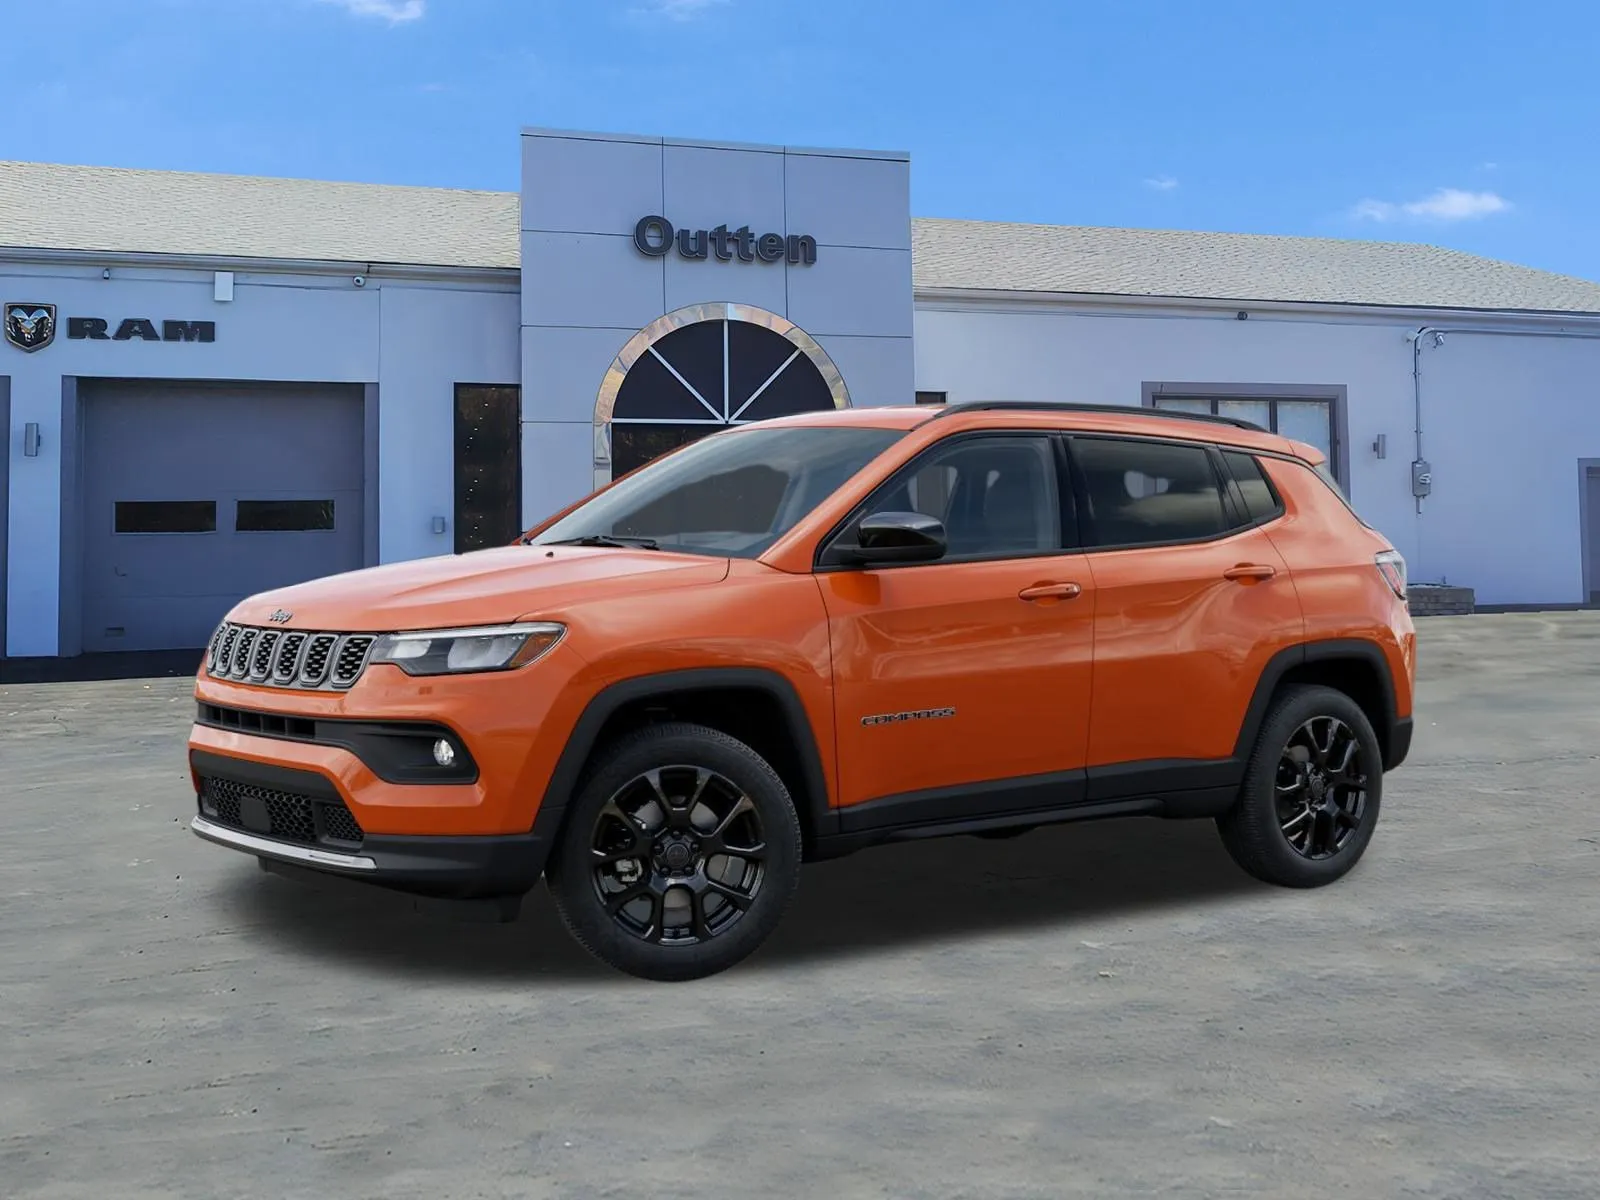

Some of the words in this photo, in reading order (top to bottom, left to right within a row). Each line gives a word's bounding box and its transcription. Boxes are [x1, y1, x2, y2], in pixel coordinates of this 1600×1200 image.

[634, 215, 817, 264] Outten
[66, 316, 216, 343] RAM
[861, 707, 955, 726] COMPASS
